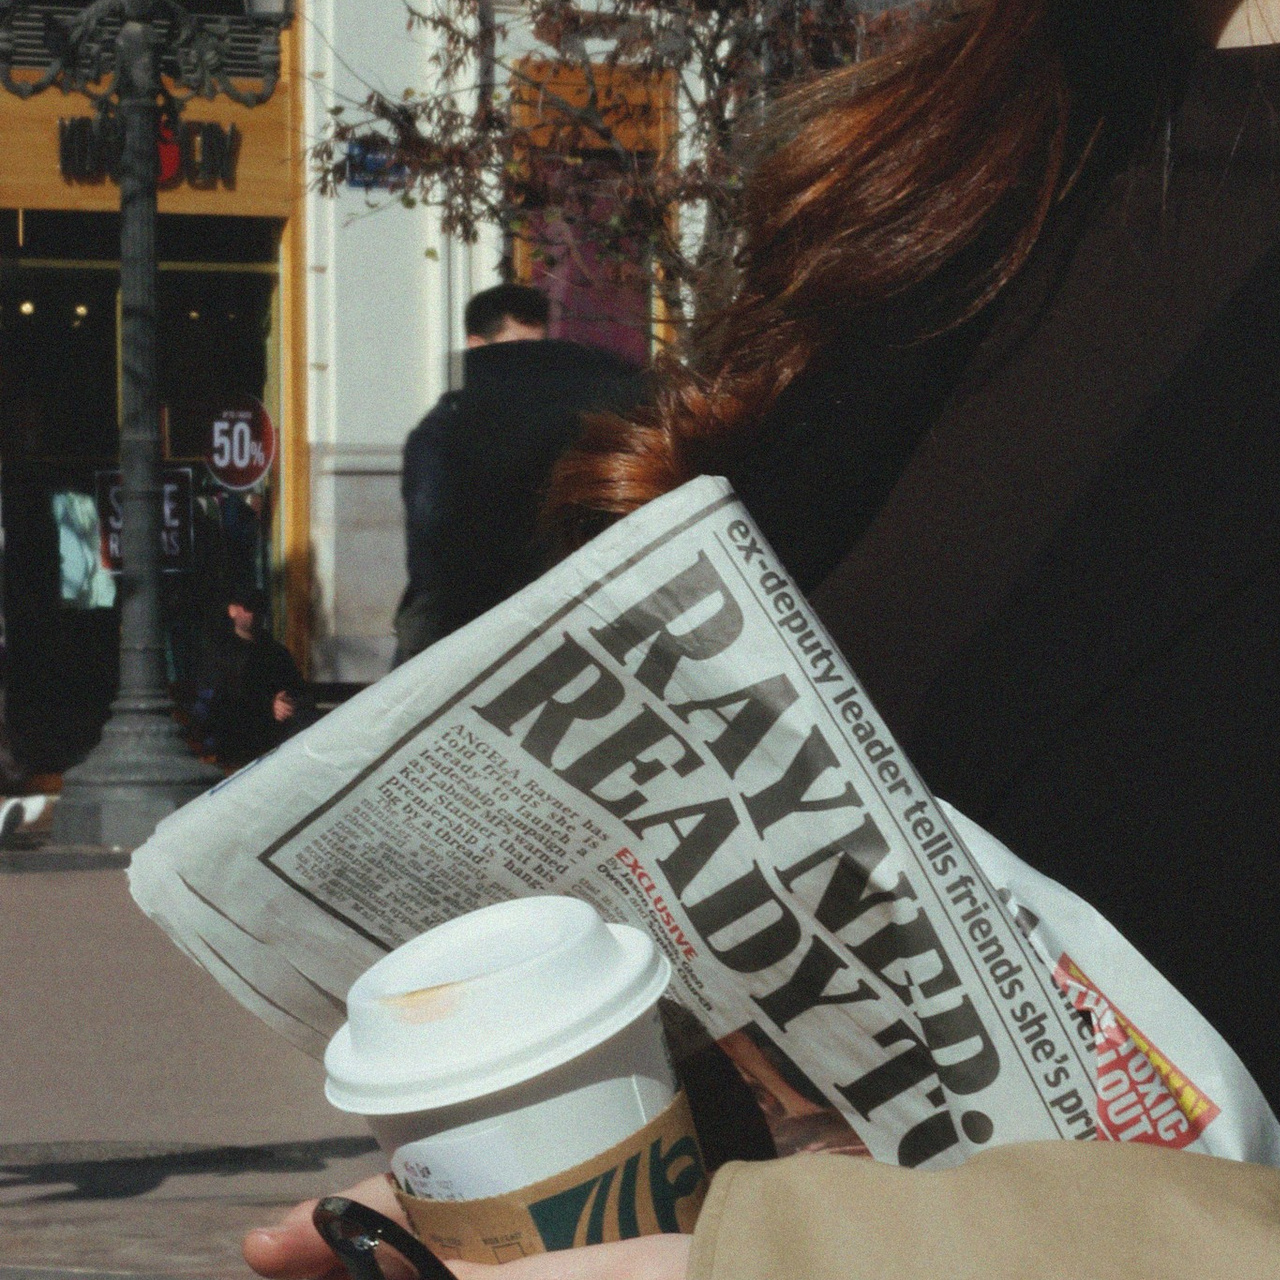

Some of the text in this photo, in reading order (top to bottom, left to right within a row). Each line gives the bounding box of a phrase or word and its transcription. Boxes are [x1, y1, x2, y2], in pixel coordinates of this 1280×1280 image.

[212, 420, 265, 468] 50%
[109, 483, 179, 529] SE
[375, 784, 404, 806] ing
[401, 803, 423, 819] by
[384, 775, 480, 845] premiership
[481, 843, 499, 857] is
[397, 766, 559, 883] Keir Starmer that his
[407, 758, 569, 874] as Labour MPs warned
[417, 749, 497, 808] leadership
[495, 806, 567, 858] campaign
[439, 732, 601, 849] told friends she is
[449, 722, 611, 841] ANGELA Rayner has
[471, 630, 875, 1035] READY
[491, 786, 511, 801] to
[515, 803, 572, 844] launch
[726, 519, 845, 687] ex-deputy
[832, 688, 914, 803] leader
[902, 800, 960, 878] tells
[945, 877, 1026, 1003] friends
[1010, 998, 1070, 1091] she's
[596, 864, 630, 896] Owen
[606, 857, 622, 873] By
[621, 871, 651, 909] Jason
[616, 847, 698, 959] EXCLUSIVE
[1119, 1038, 1189, 1142] TOXIC
